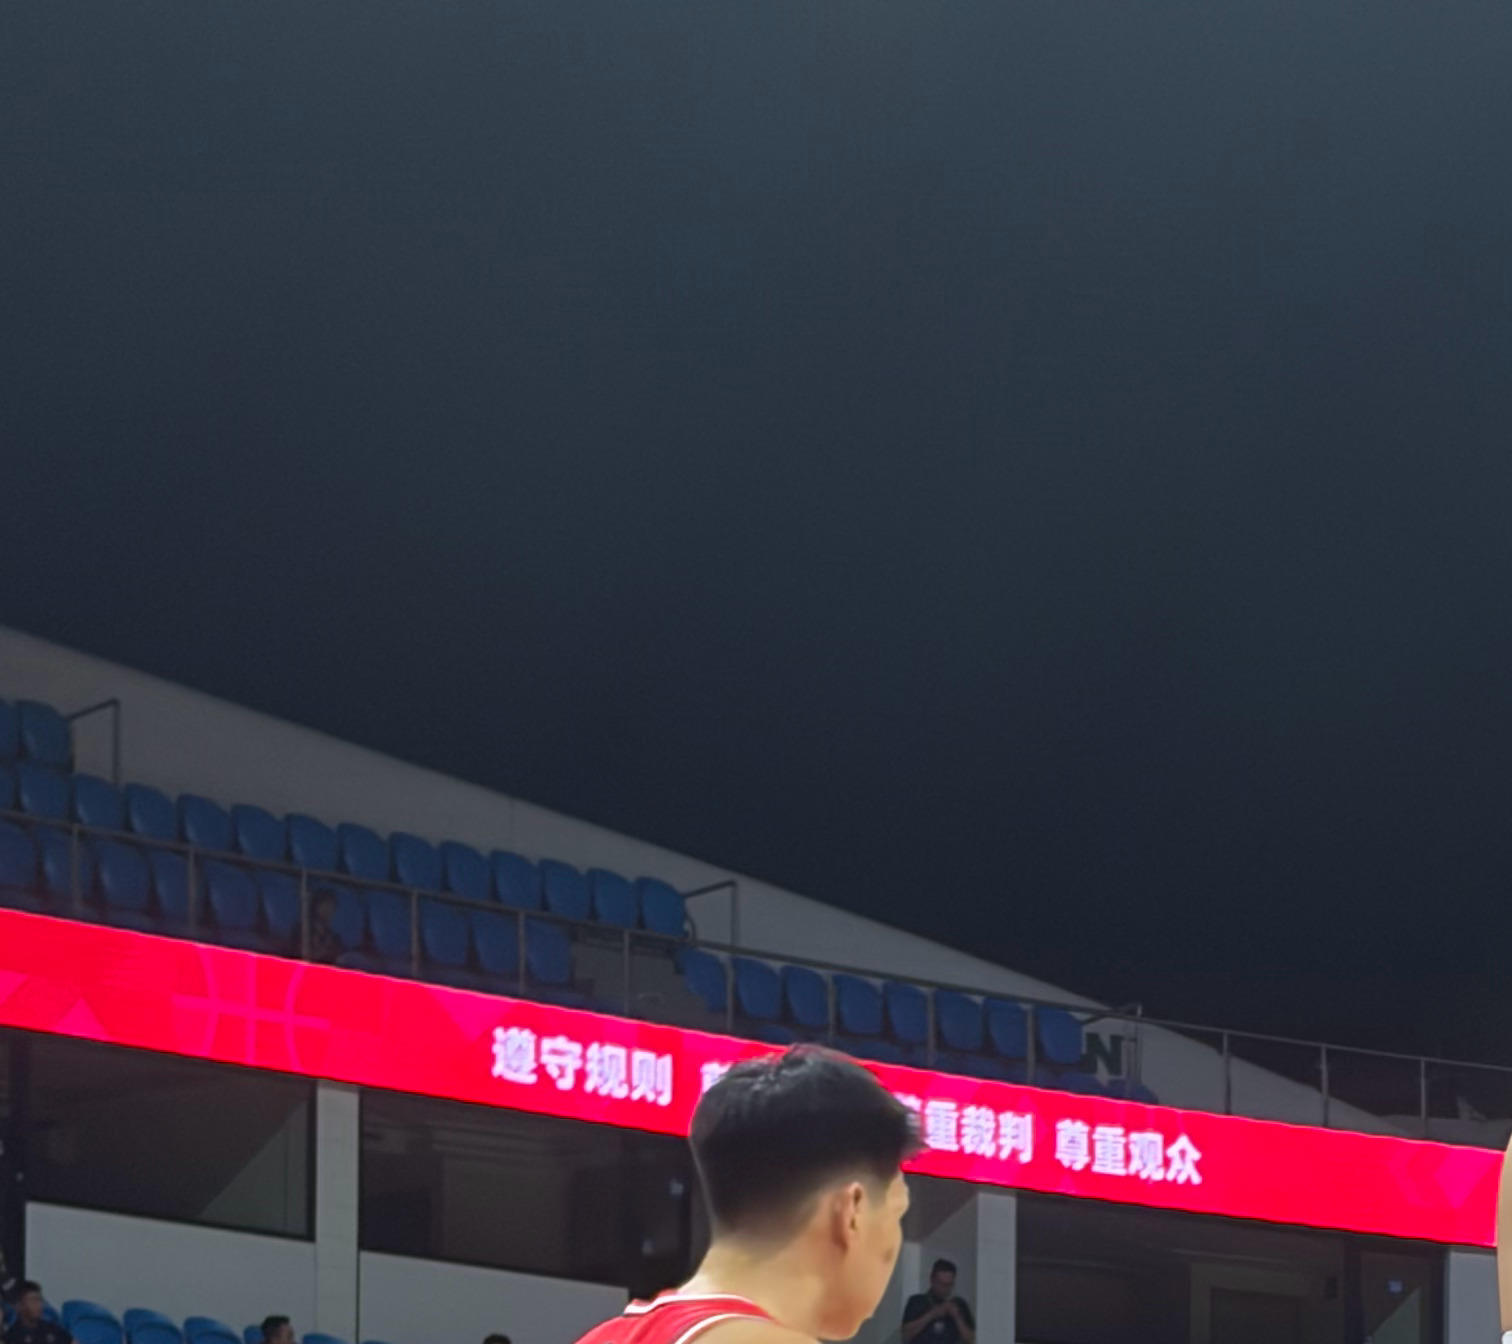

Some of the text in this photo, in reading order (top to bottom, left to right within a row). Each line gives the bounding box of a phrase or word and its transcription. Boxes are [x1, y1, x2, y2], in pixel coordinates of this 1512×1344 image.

[491, 1026, 674, 1106] 遵守规则
[1055, 1118, 1202, 1186] 尊重观众
